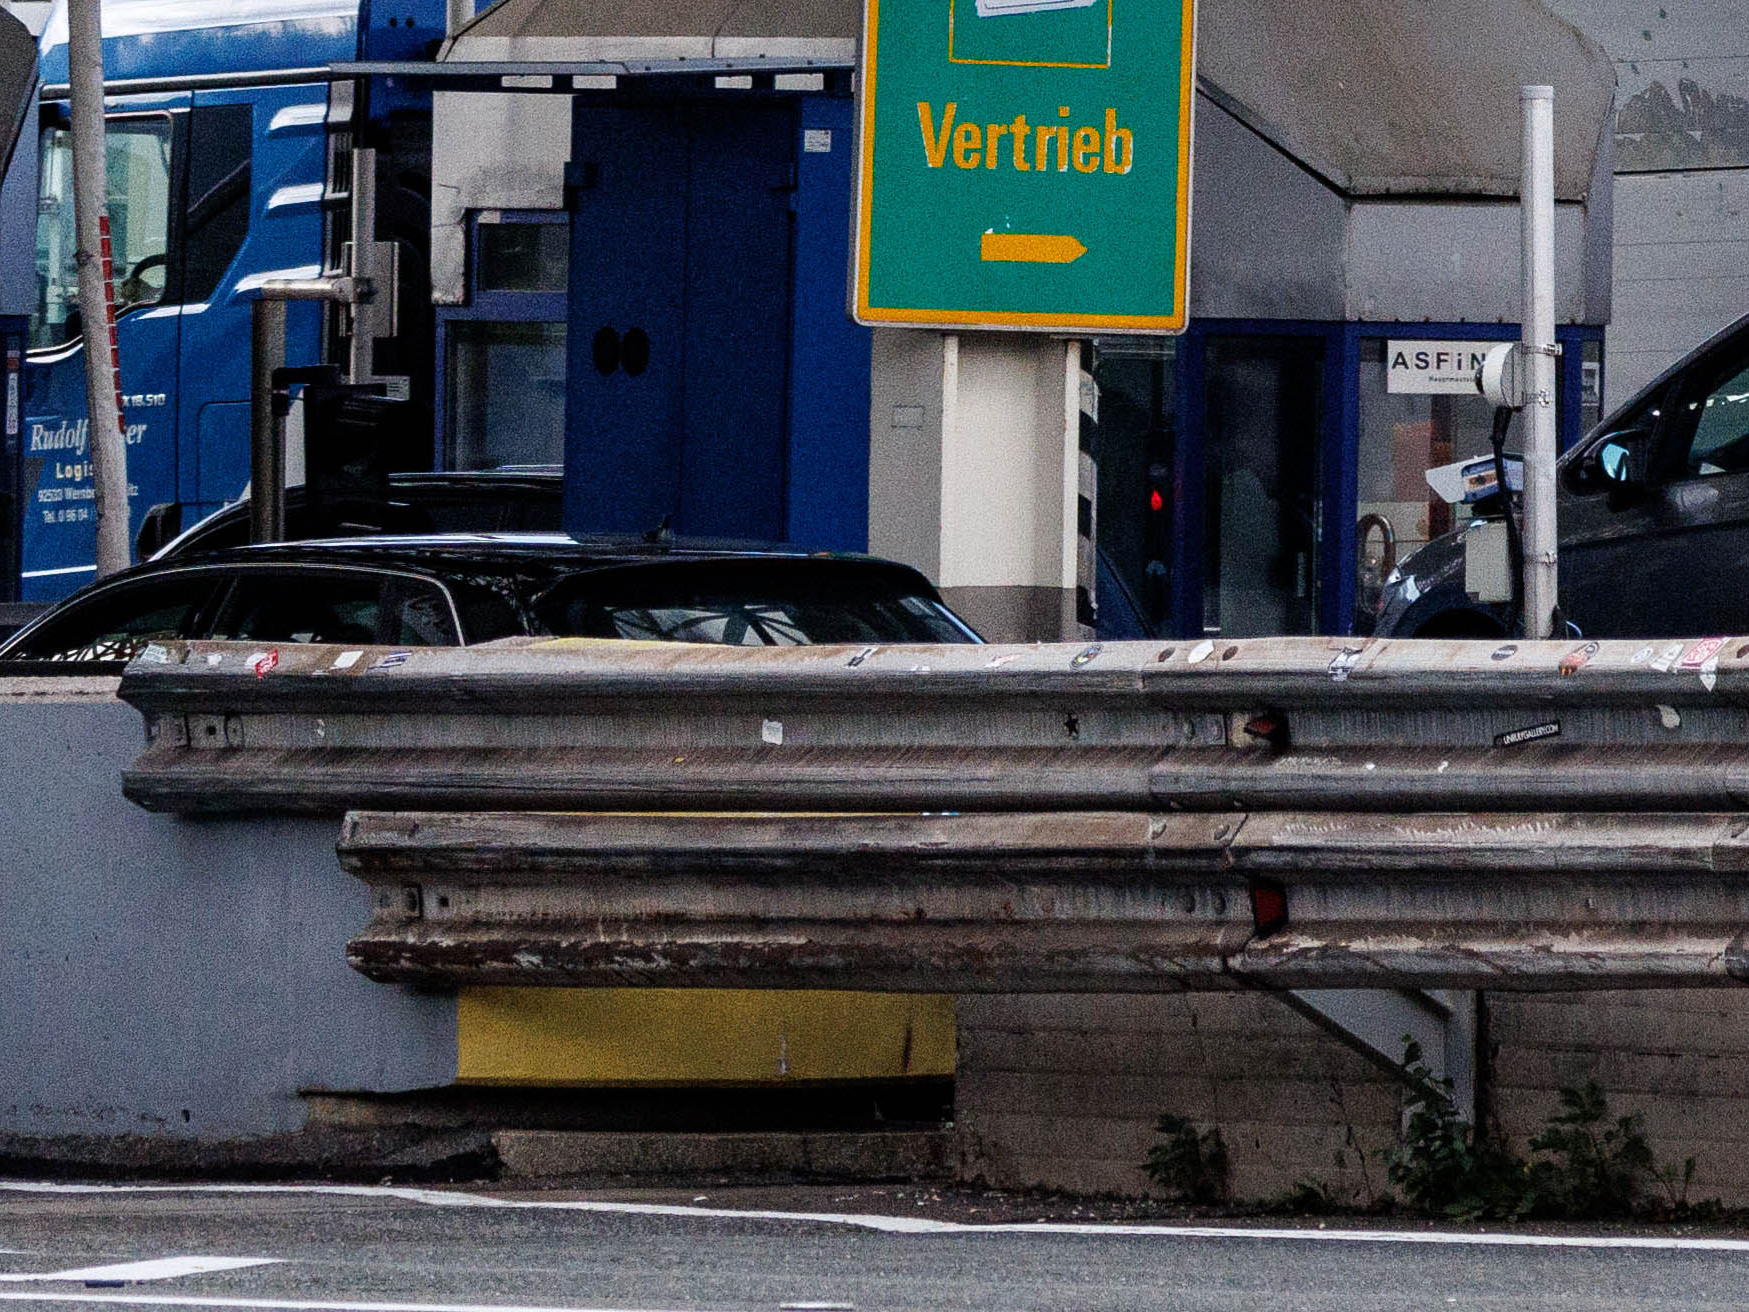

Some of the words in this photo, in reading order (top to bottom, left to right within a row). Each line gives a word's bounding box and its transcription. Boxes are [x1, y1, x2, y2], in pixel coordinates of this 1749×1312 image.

[916, 100, 1135, 176] Vertrieb
[1390, 350, 1487, 371] ASFiN
[30, 418, 90, 456] Rudolf
